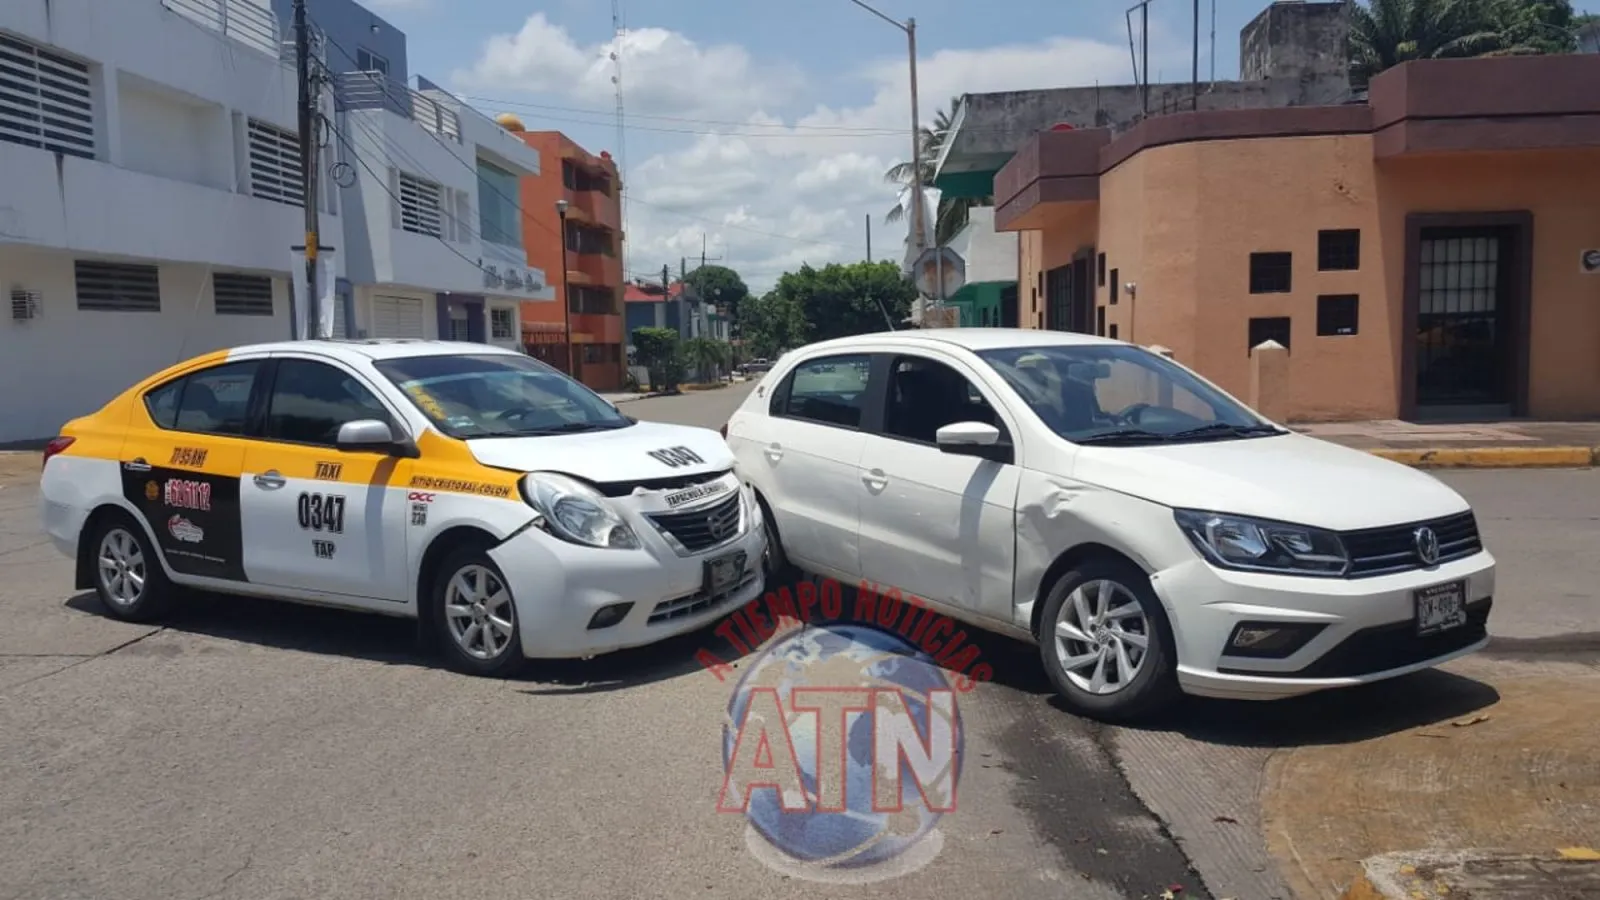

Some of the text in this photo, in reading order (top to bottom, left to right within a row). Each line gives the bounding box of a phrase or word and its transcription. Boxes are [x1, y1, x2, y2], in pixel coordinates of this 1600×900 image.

[646, 446, 707, 468] 0347
[316, 463, 342, 480] TAXI
[480, 485, 510, 496] COLON
[298, 492, 347, 534] 0347
[312, 540, 336, 559] TAP
